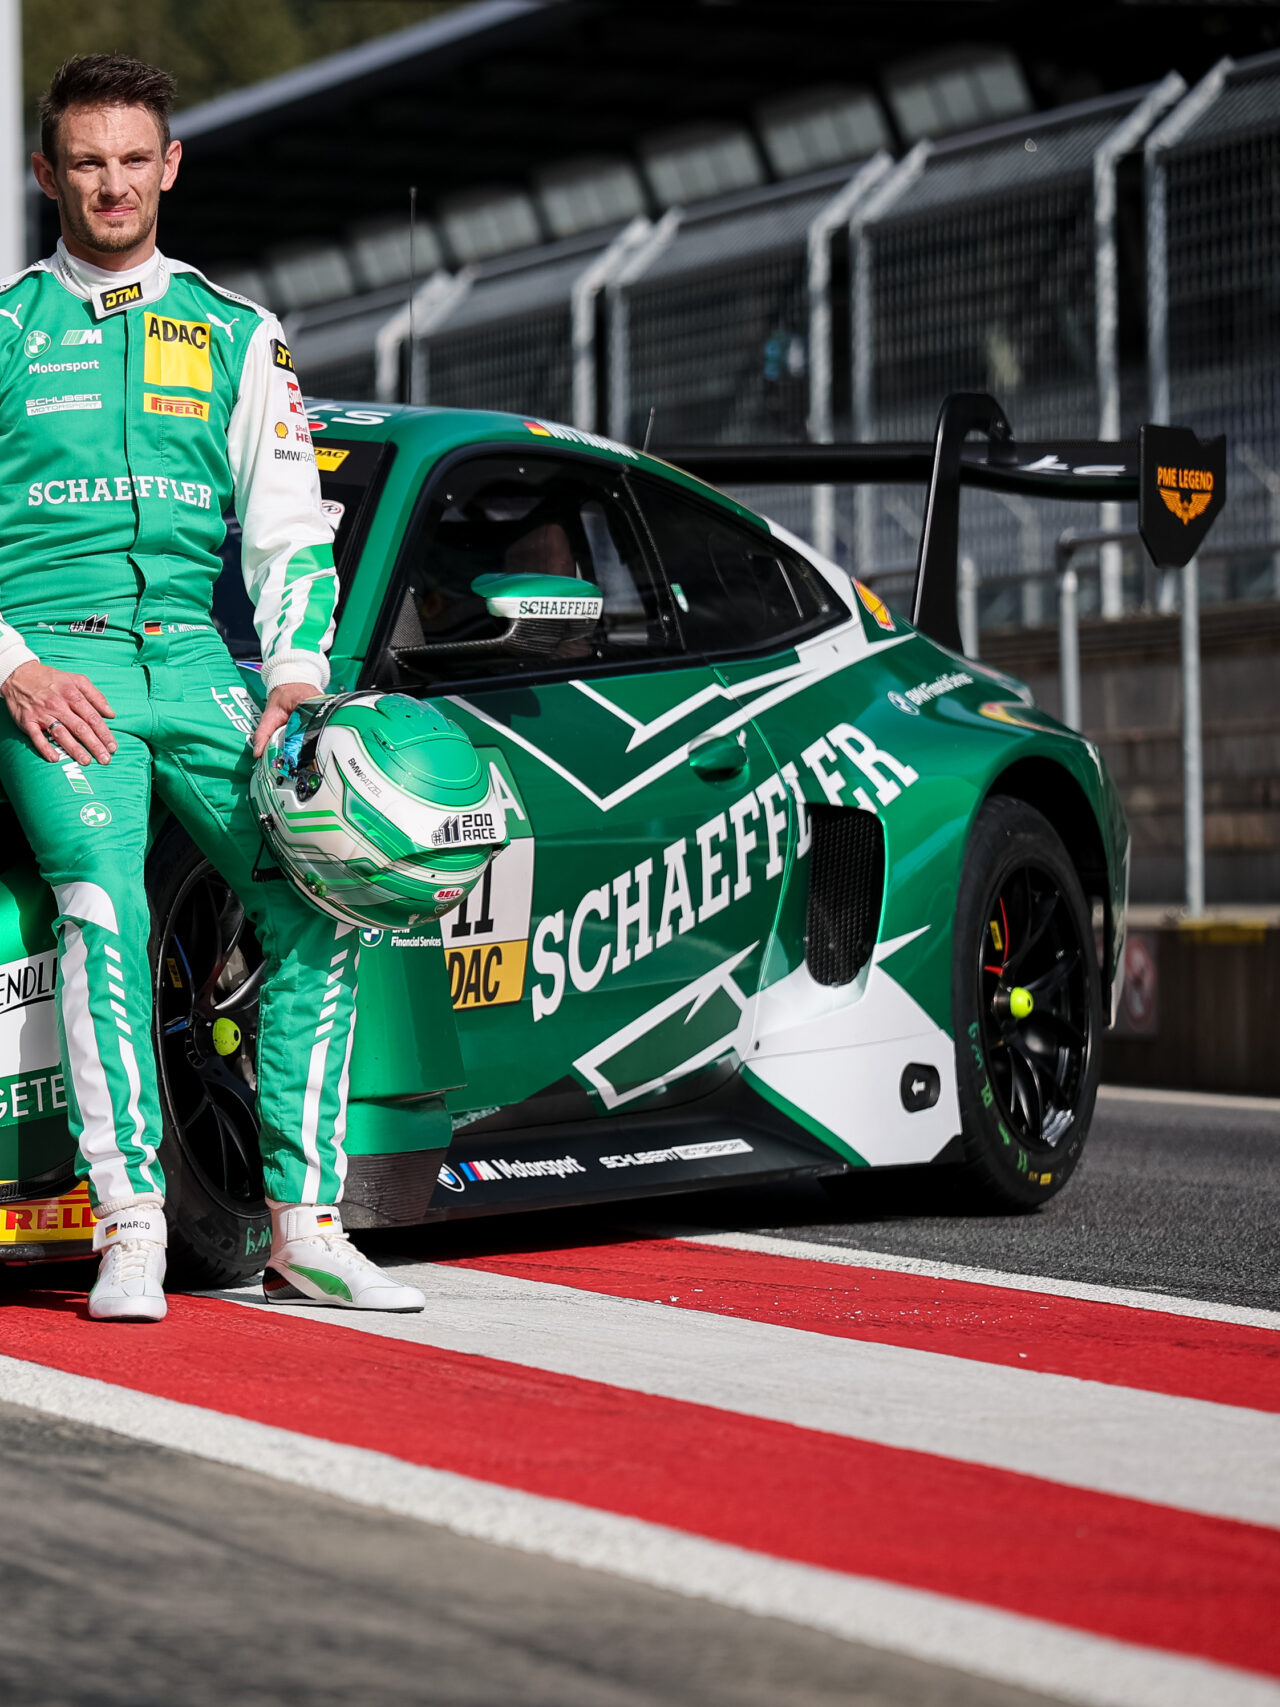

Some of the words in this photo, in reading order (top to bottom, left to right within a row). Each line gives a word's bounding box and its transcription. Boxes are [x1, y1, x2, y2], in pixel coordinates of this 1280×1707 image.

[105, 284, 140, 308] DTM
[148, 316, 207, 350] ADAC
[28, 359, 100, 375] Motorsport
[25, 393, 102, 408] SCHUBERT
[29, 402, 100, 415] MOTORSPORT
[151, 396, 204, 417] PIRELLI
[1157, 465, 1177, 488] PME
[1177, 469, 1214, 491] LEGEND
[28, 475, 212, 510] SCHAEFFLER
[519, 600, 599, 616] SCHAEFFLER
[461, 813, 494, 828] 200
[462, 827, 497, 842] RACE
[531, 722, 920, 1023] SCHAEFFLER
[437, 889, 461, 898] BELL
[391, 935, 420, 947] Financial
[420, 935, 442, 947] Services
[491, 1155, 587, 1179] Motorsport
[120, 1220, 151, 1231] MARCO
